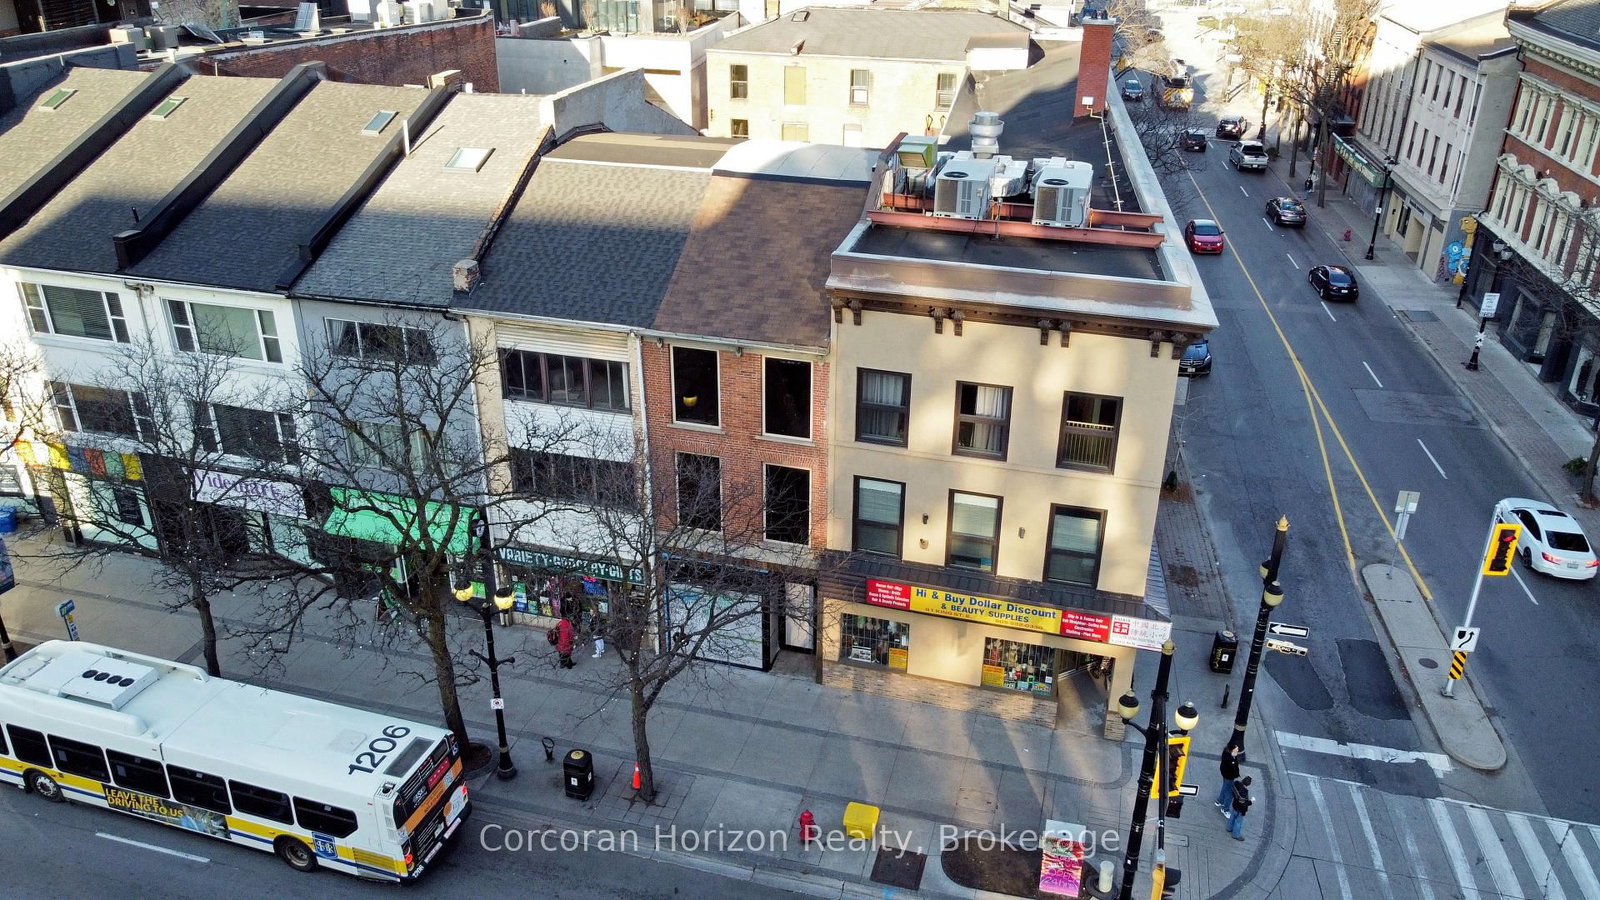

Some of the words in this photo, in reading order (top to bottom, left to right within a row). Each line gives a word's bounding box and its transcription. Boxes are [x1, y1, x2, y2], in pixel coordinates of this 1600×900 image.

[916, 588, 926, 598] Hi
[931, 590, 939, 600] &
[944, 592, 966, 606] Buy
[969, 597, 1002, 611] Dollar
[1006, 603, 1056, 619] Discount
[940, 602, 947, 610] &
[950, 604, 985, 616] BEAUTY
[988, 611, 1030, 623] SUPPLIES
[348, 725, 411, 775] 1206
[106, 788, 137, 802] LEAVE
[138, 795, 159, 806] THE
[108, 796, 152, 812] DRIVING
[153, 805, 168, 815] TO
[170, 808, 184, 818] US
